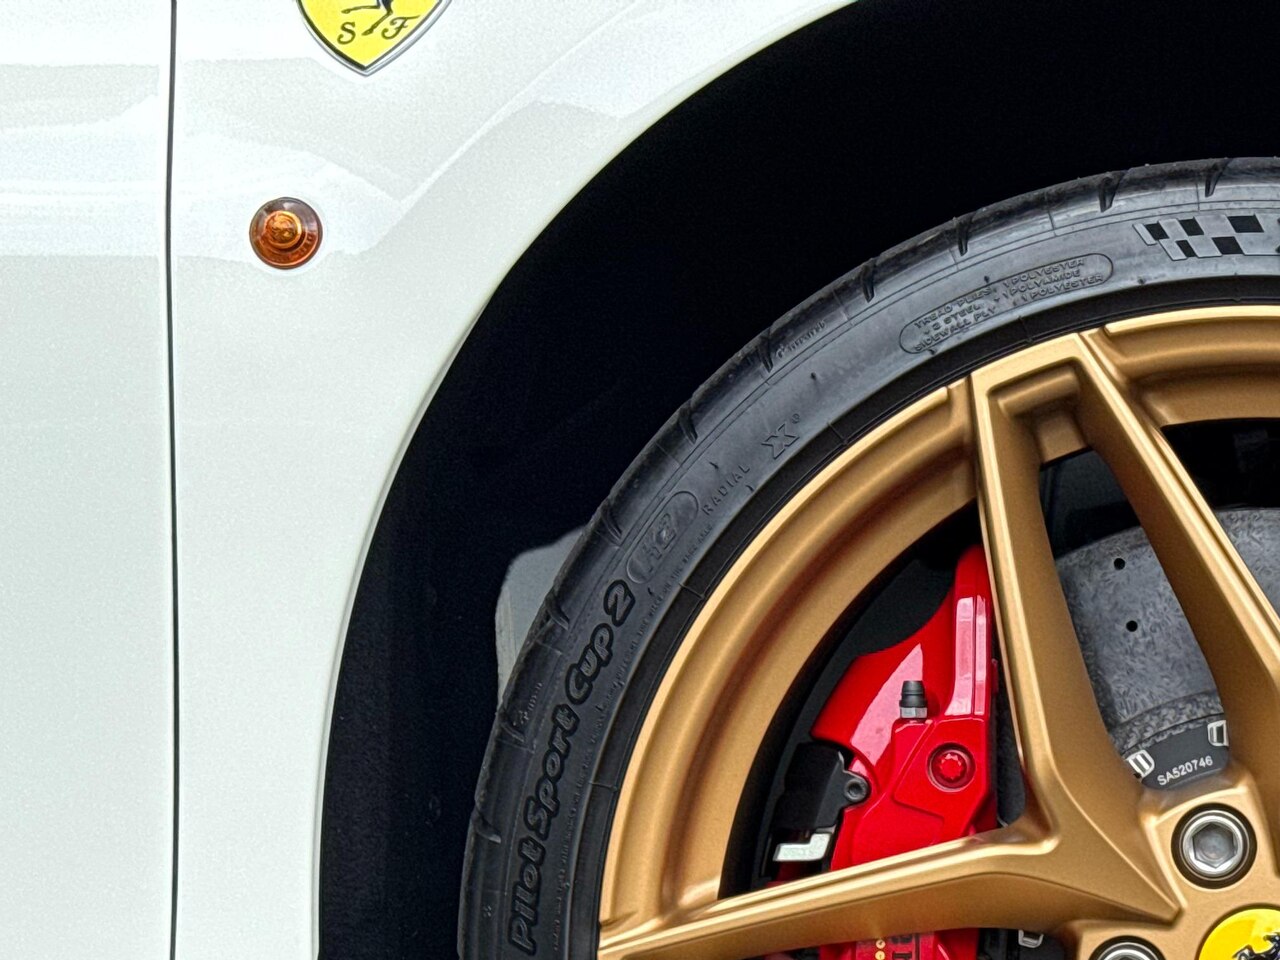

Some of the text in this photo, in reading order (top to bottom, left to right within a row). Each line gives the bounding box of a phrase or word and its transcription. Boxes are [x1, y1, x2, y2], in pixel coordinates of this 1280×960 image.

[337, 15, 420, 45] S F
[594, 575, 641, 627] 2
[557, 616, 623, 709] Cup
[519, 701, 586, 842] Sport
[1157, 755, 1214, 787] SA520746
[508, 835, 547, 952] Pilot
